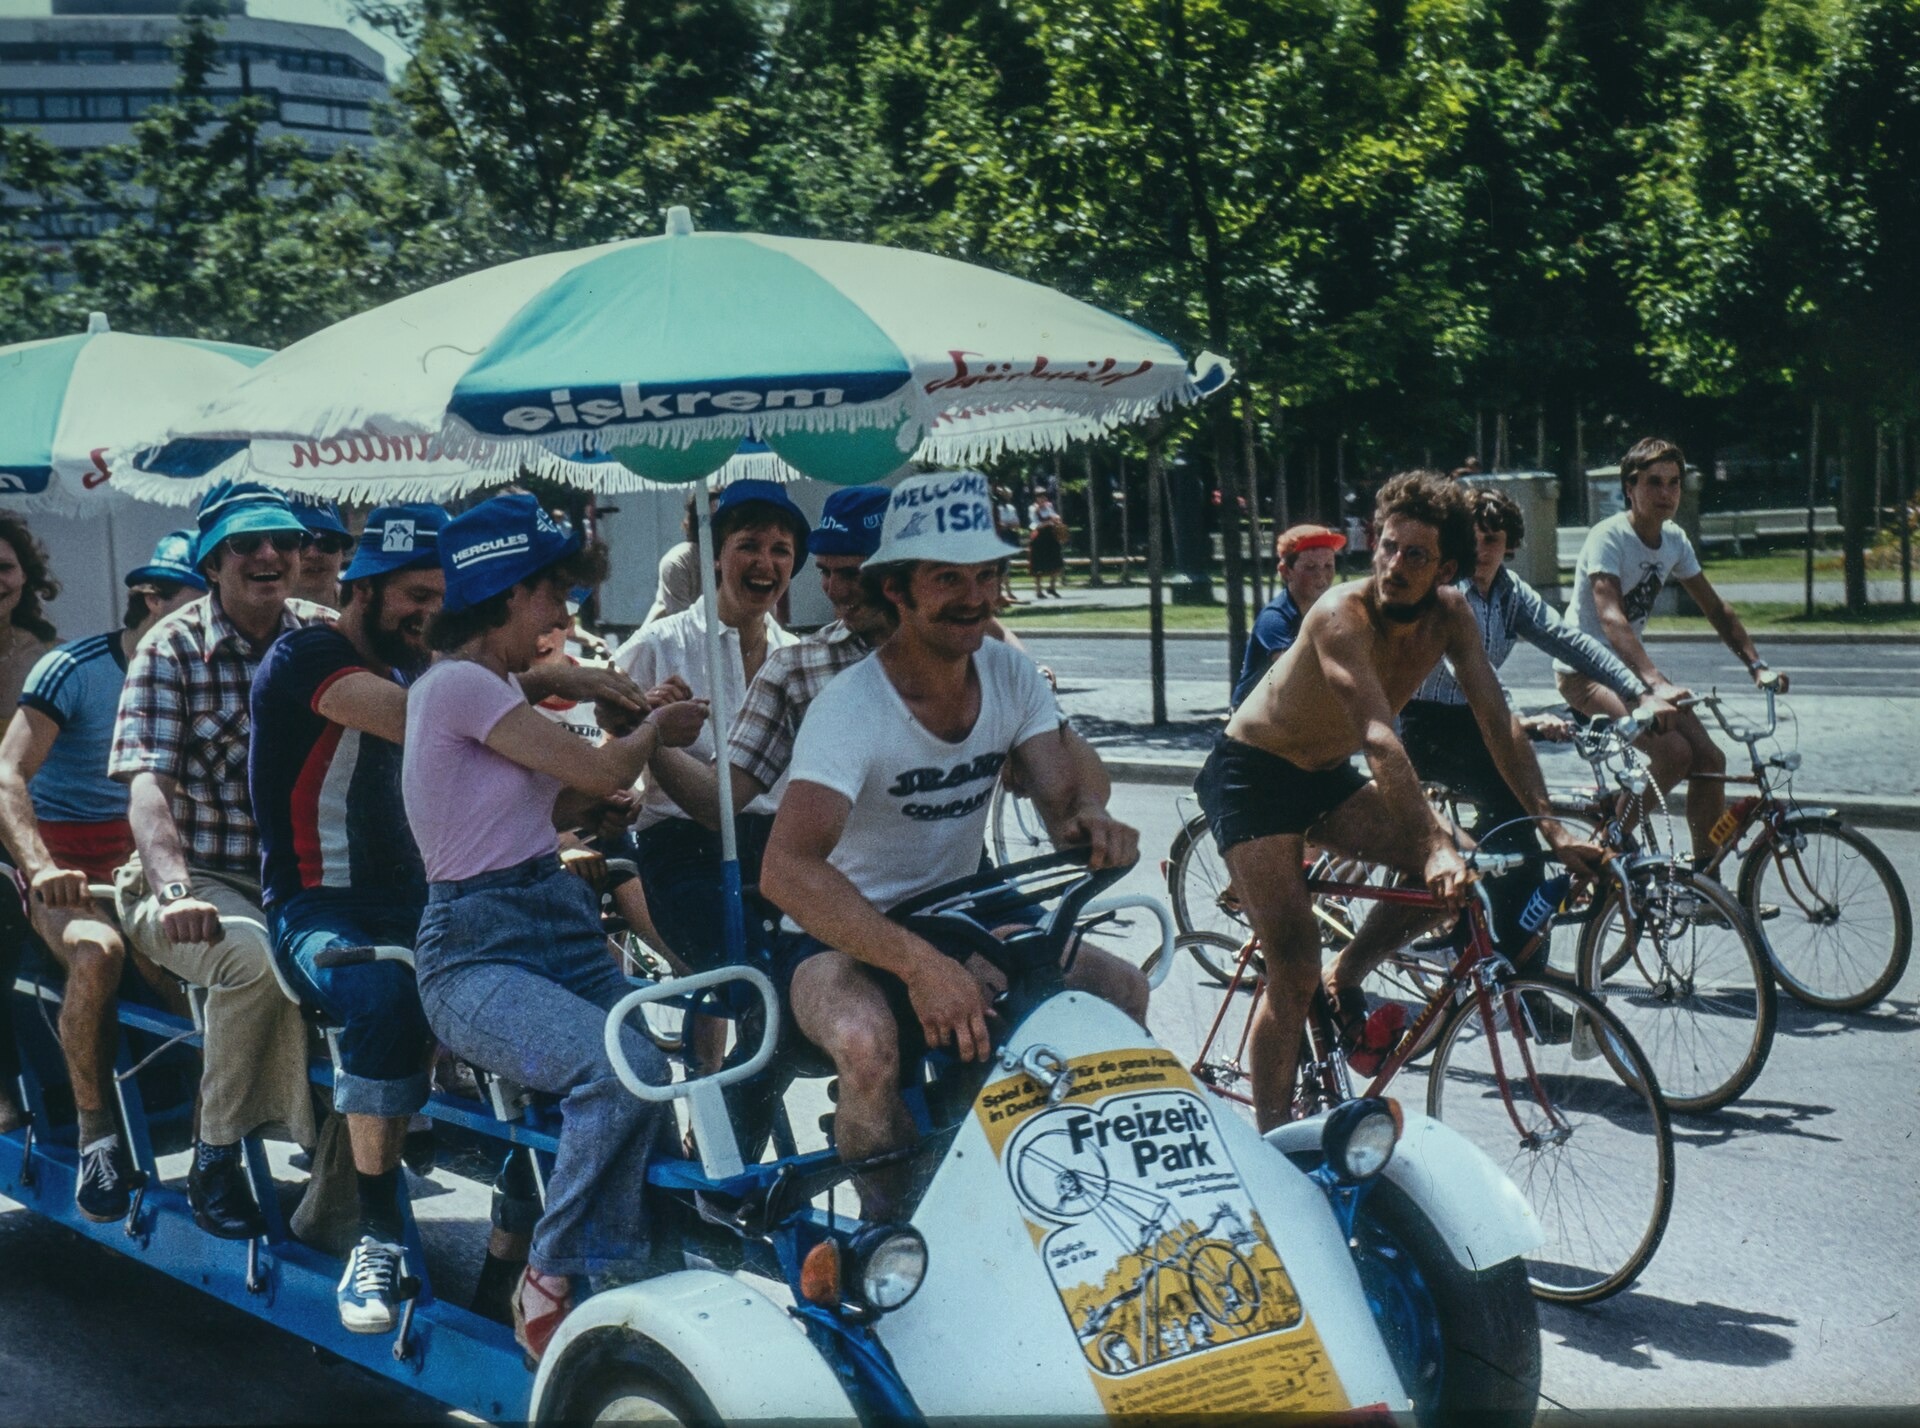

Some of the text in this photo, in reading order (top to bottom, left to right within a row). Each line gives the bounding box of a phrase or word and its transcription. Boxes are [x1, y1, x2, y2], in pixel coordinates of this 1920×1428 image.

[503, 381, 844, 431] eiskrem
[452, 533, 529, 564] HERCULES
[983, 1085, 1019, 1108] Spiel
[1131, 1133, 1216, 1178] Park
